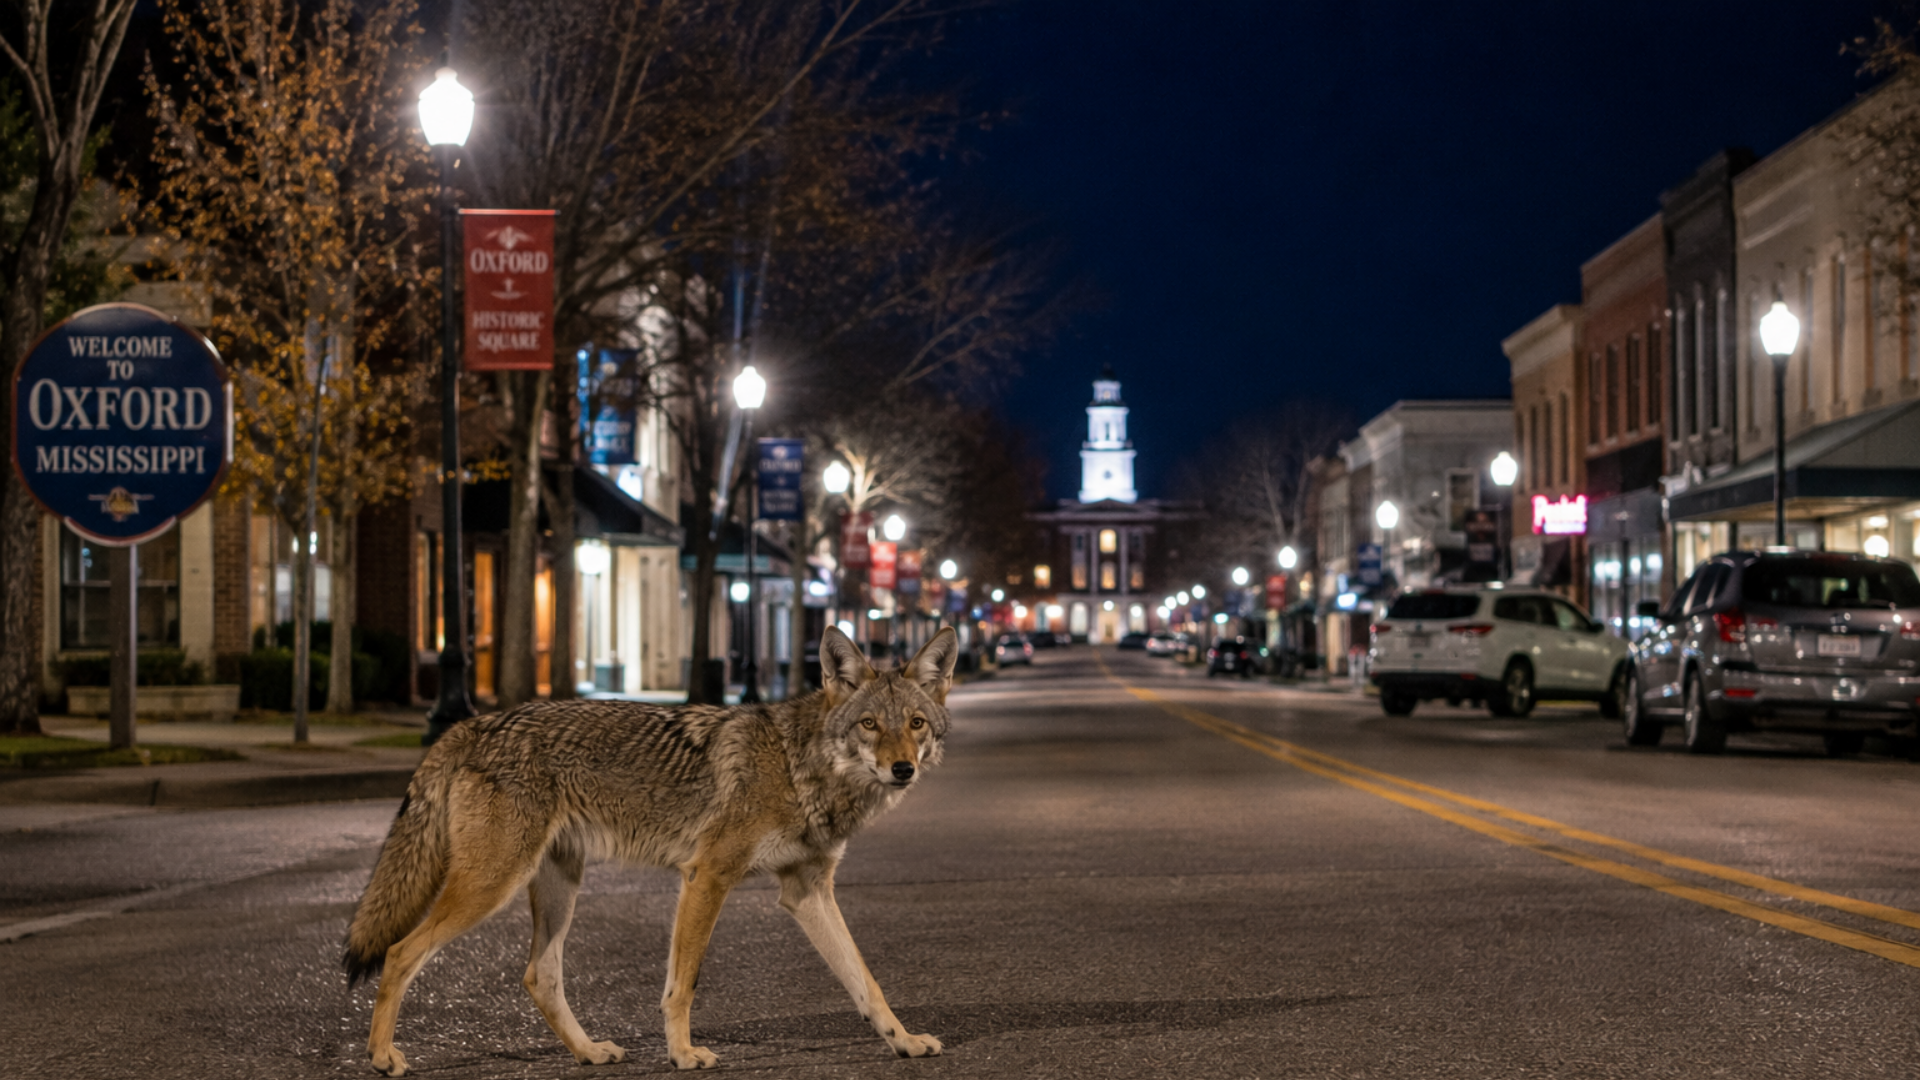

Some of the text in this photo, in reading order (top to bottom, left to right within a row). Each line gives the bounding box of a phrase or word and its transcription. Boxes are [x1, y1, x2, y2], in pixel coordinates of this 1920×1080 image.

[470, 248, 549, 274] OXFORD
[472, 311, 545, 329] HISTORIC
[68, 336, 173, 358] WELCOME
[477, 331, 541, 353] SQUARE
[107, 360, 135, 380] TO
[29, 378, 212, 431] OXFORD
[36, 445, 206, 475] MISSISSIPPI
